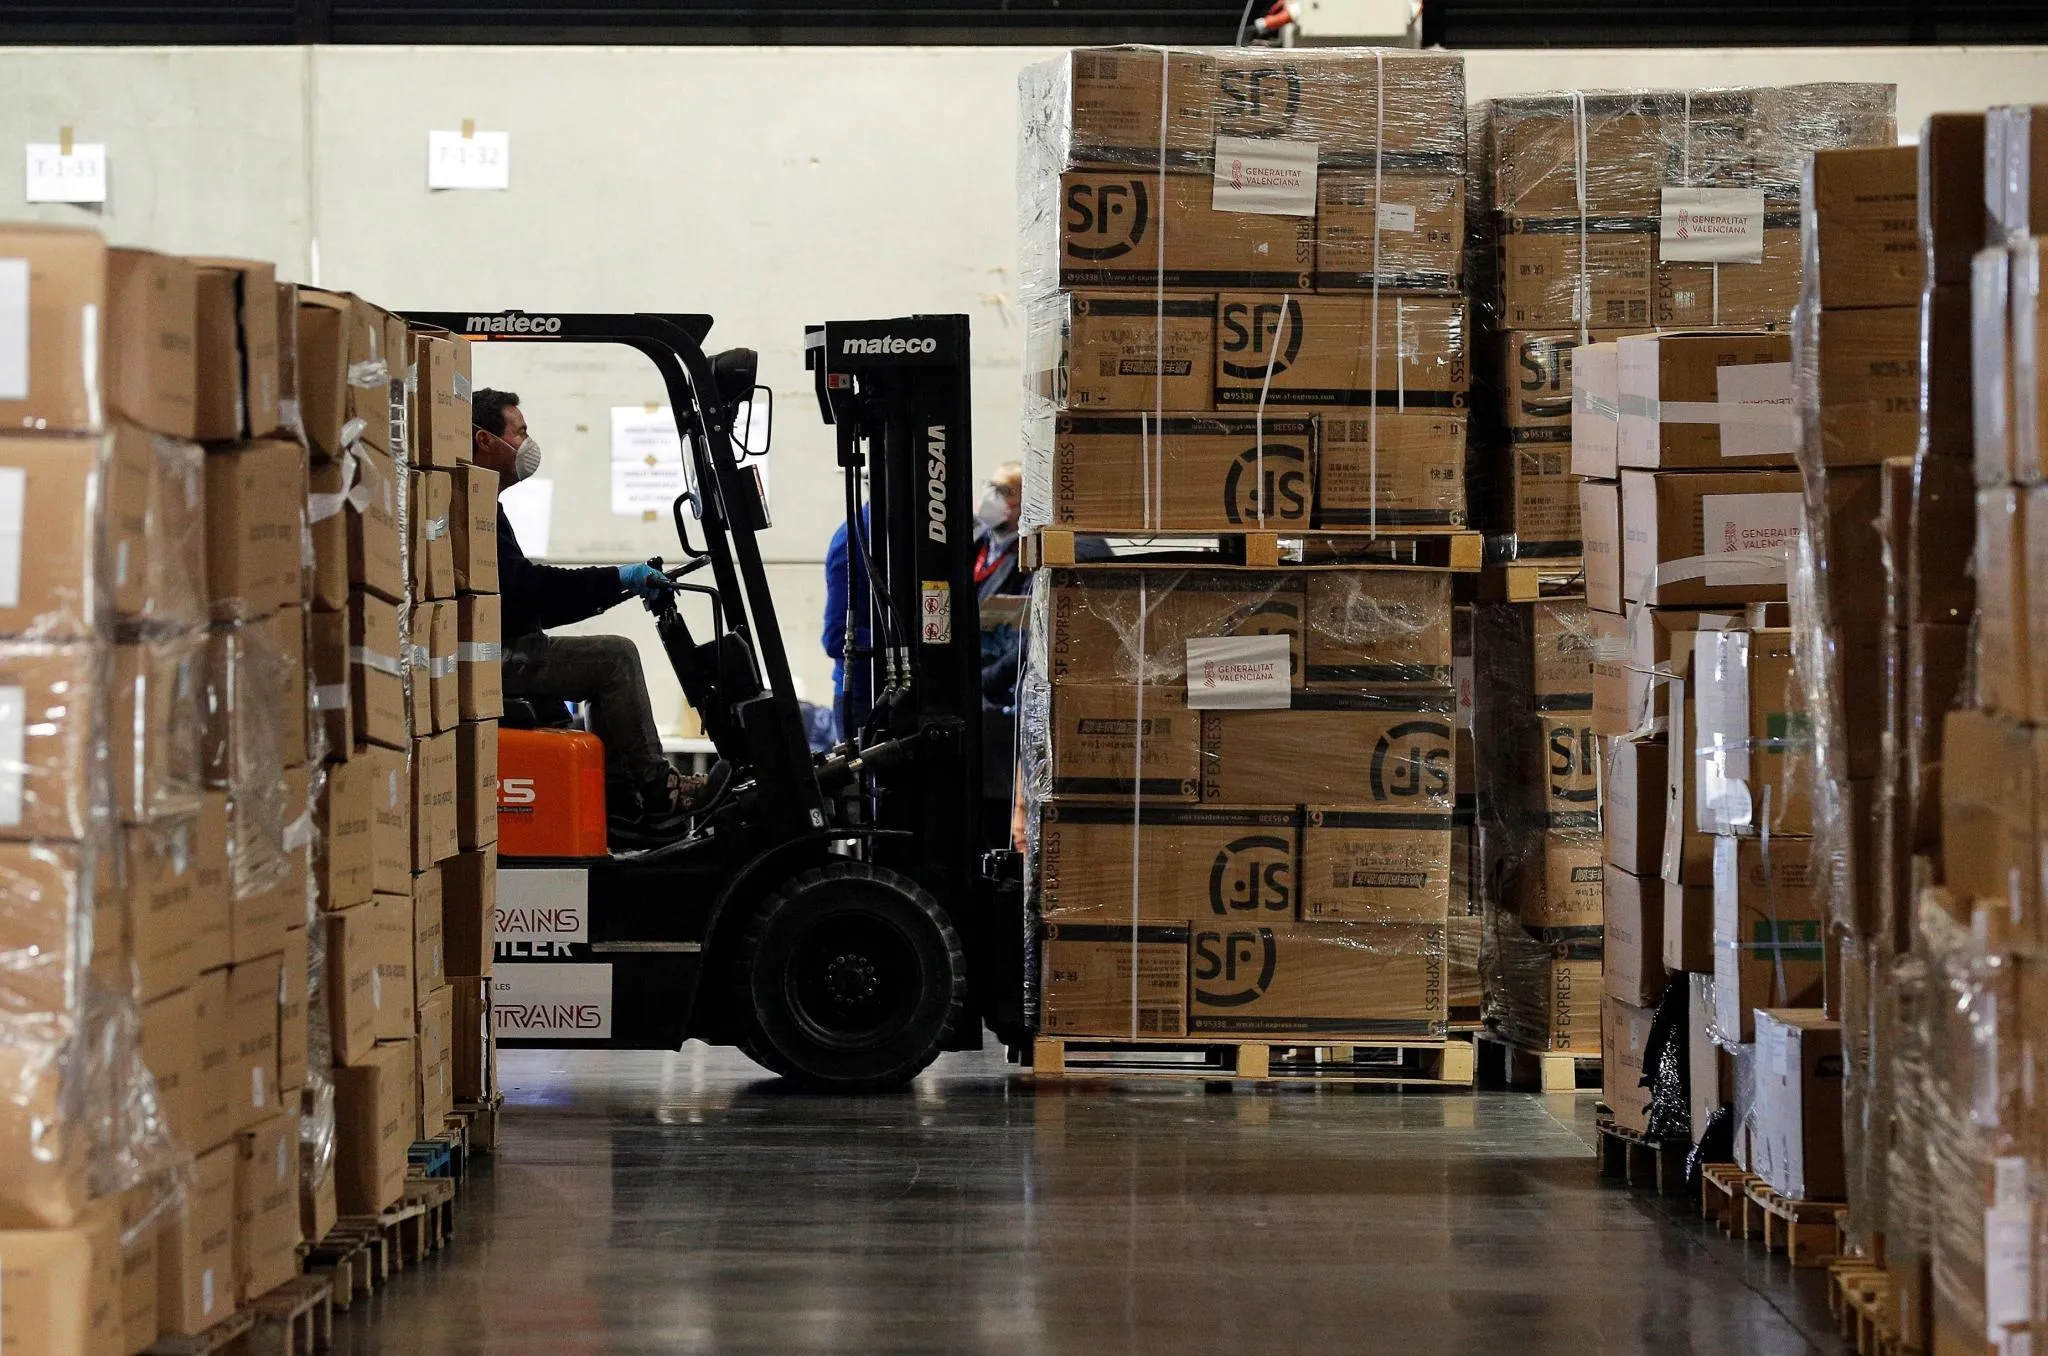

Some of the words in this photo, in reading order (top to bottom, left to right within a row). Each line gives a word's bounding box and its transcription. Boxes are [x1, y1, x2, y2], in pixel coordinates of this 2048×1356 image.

[438, 146, 499, 165] T-1-32
[36, 158, 97, 177] T-1-33
[1245, 167, 1302, 178] GENERALITAT
[1246, 177, 1300, 187] VALENCIANA
[1067, 184, 1128, 234] SF
[1692, 215, 1748, 225] GENERALITAT
[1692, 225, 1747, 234] VALENCIANA
[466, 313, 561, 333] mateco
[1223, 303, 1282, 353] SF
[842, 334, 937, 355] mateco
[1520, 340, 1578, 391] SF
[1230, 392, 1254, 400] 95338
[1452, 390, 1464, 408] 6
[1060, 443, 1075, 502] EXPRESS
[1430, 468, 1454, 480] 快递
[928, 425, 947, 544] DOOSAN
[1245, 470, 1305, 520] SF
[1060, 506, 1074, 523] SF
[1056, 595, 1070, 655] EXPRESS
[1055, 660, 1069, 676] SF
[1218, 662, 1275, 674] GENERALITAT
[1219, 672, 1274, 682] VALENCIANA
[1207, 716, 1221, 775] EXPRESS
[1390, 747, 1450, 797] SF
[1207, 779, 1220, 798] SF
[1230, 862, 1289, 912] SF
[1196, 930, 1257, 981] SF
[1425, 954, 1440, 1012] EXPRESS
[1556, 967, 1571, 1026] EXPRESS
[1556, 1031, 1571, 1049] SF
